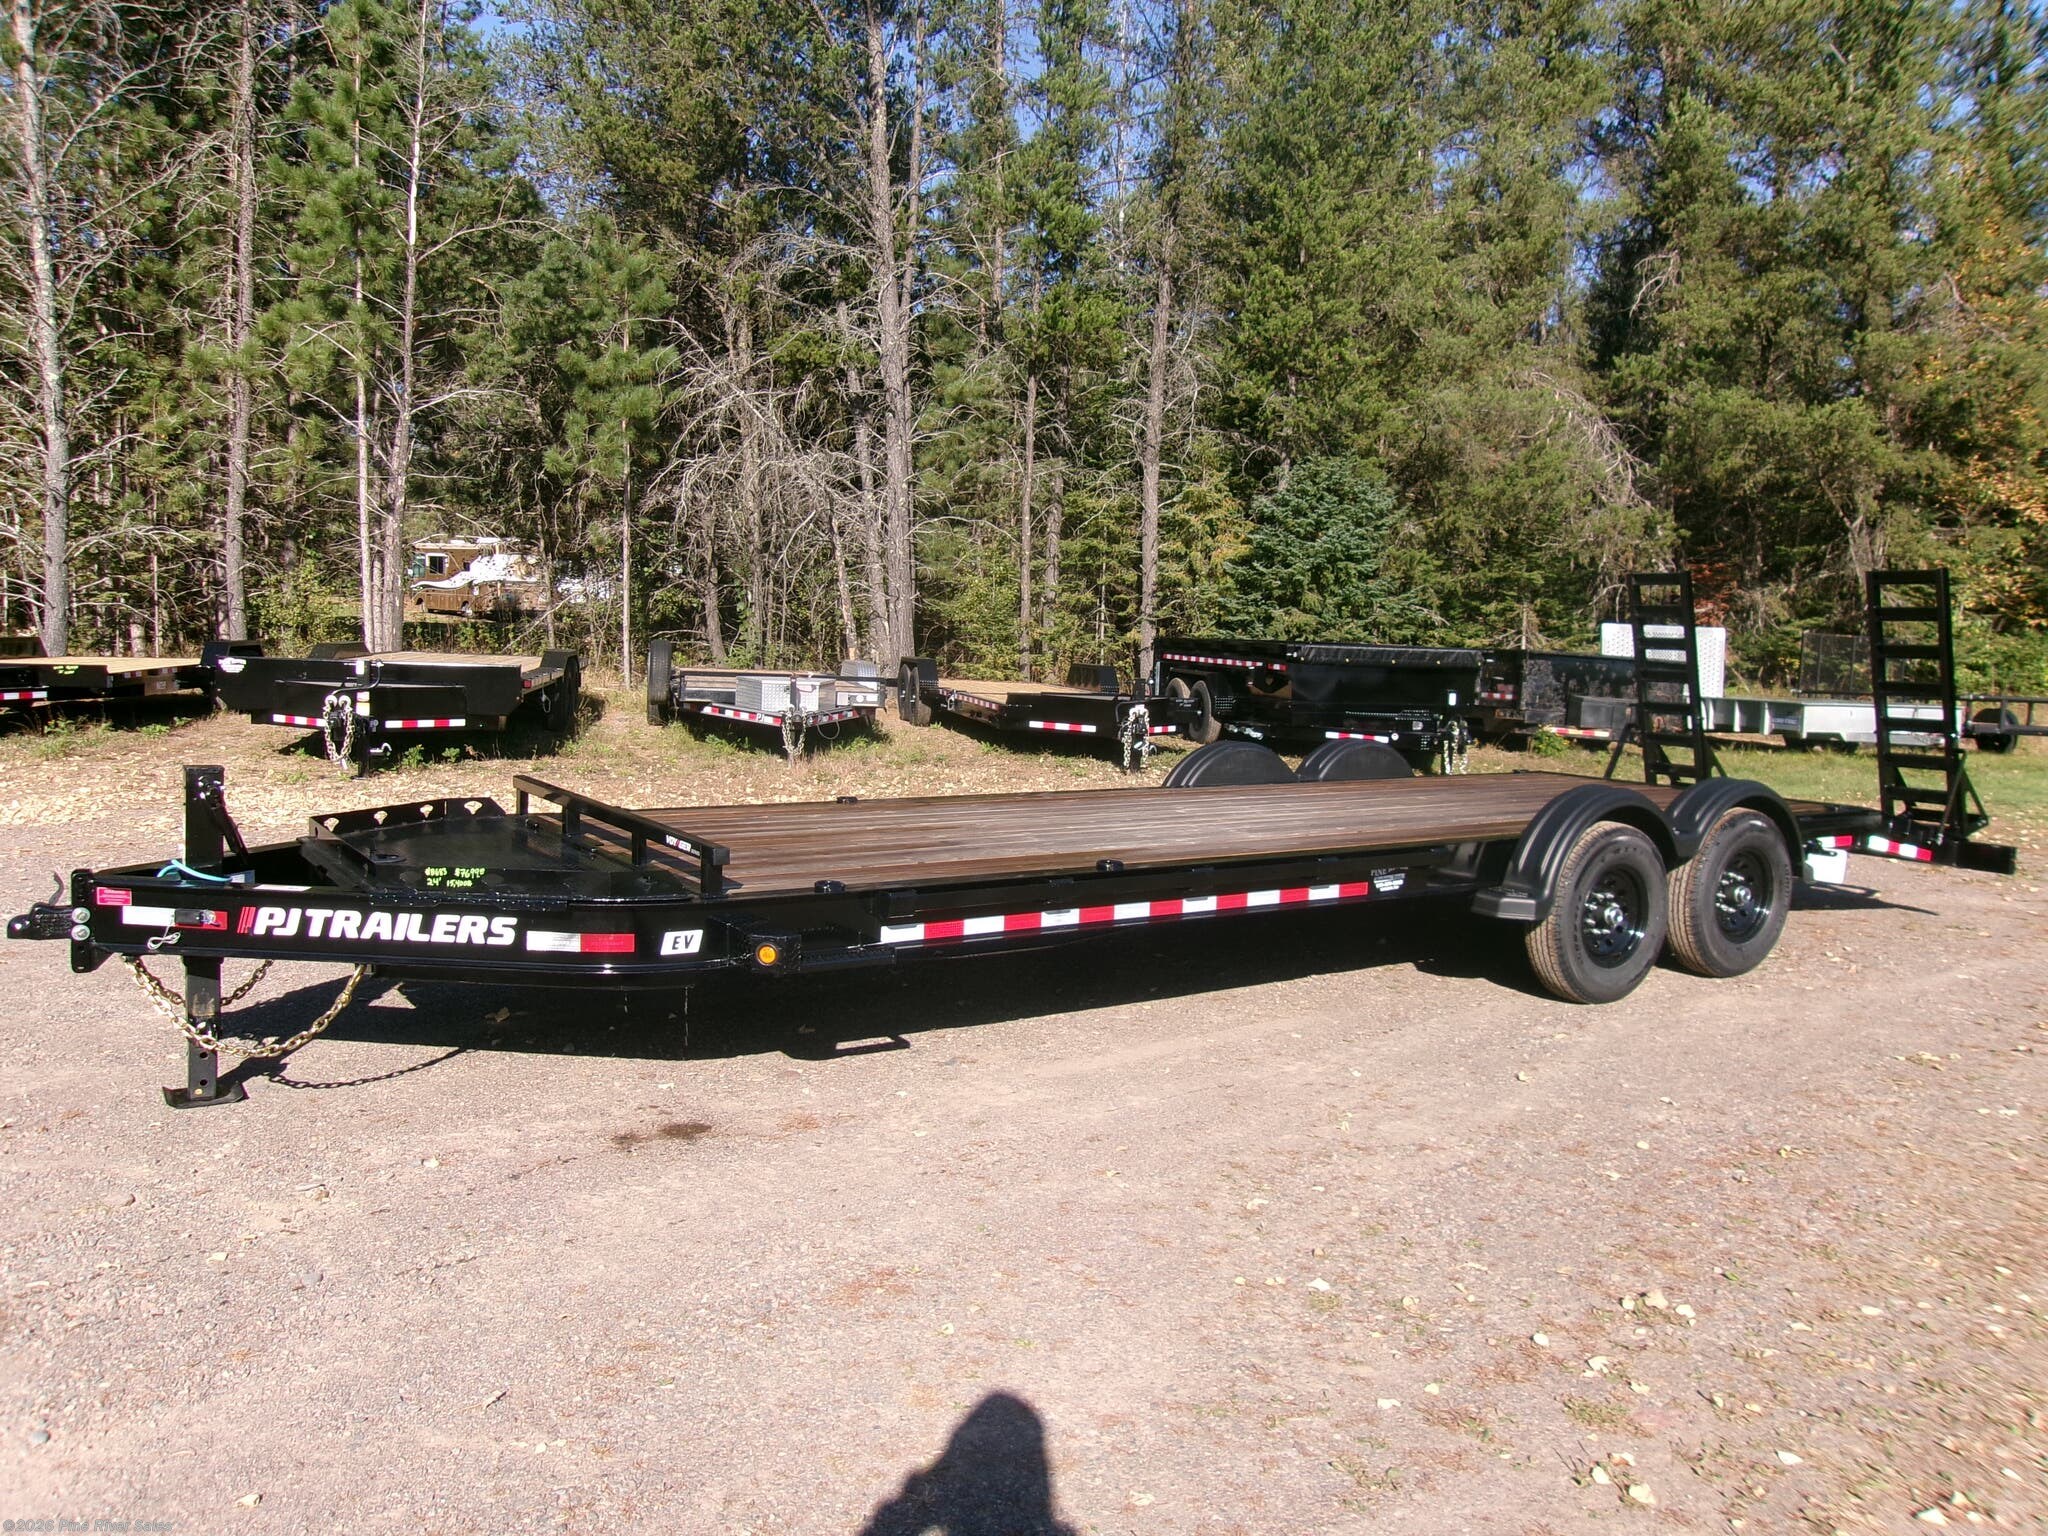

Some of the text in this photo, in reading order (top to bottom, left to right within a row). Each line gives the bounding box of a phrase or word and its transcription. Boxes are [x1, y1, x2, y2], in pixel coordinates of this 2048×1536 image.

[253, 907, 518, 946] PJ TRAILERS
[672, 935, 694, 950] EV
